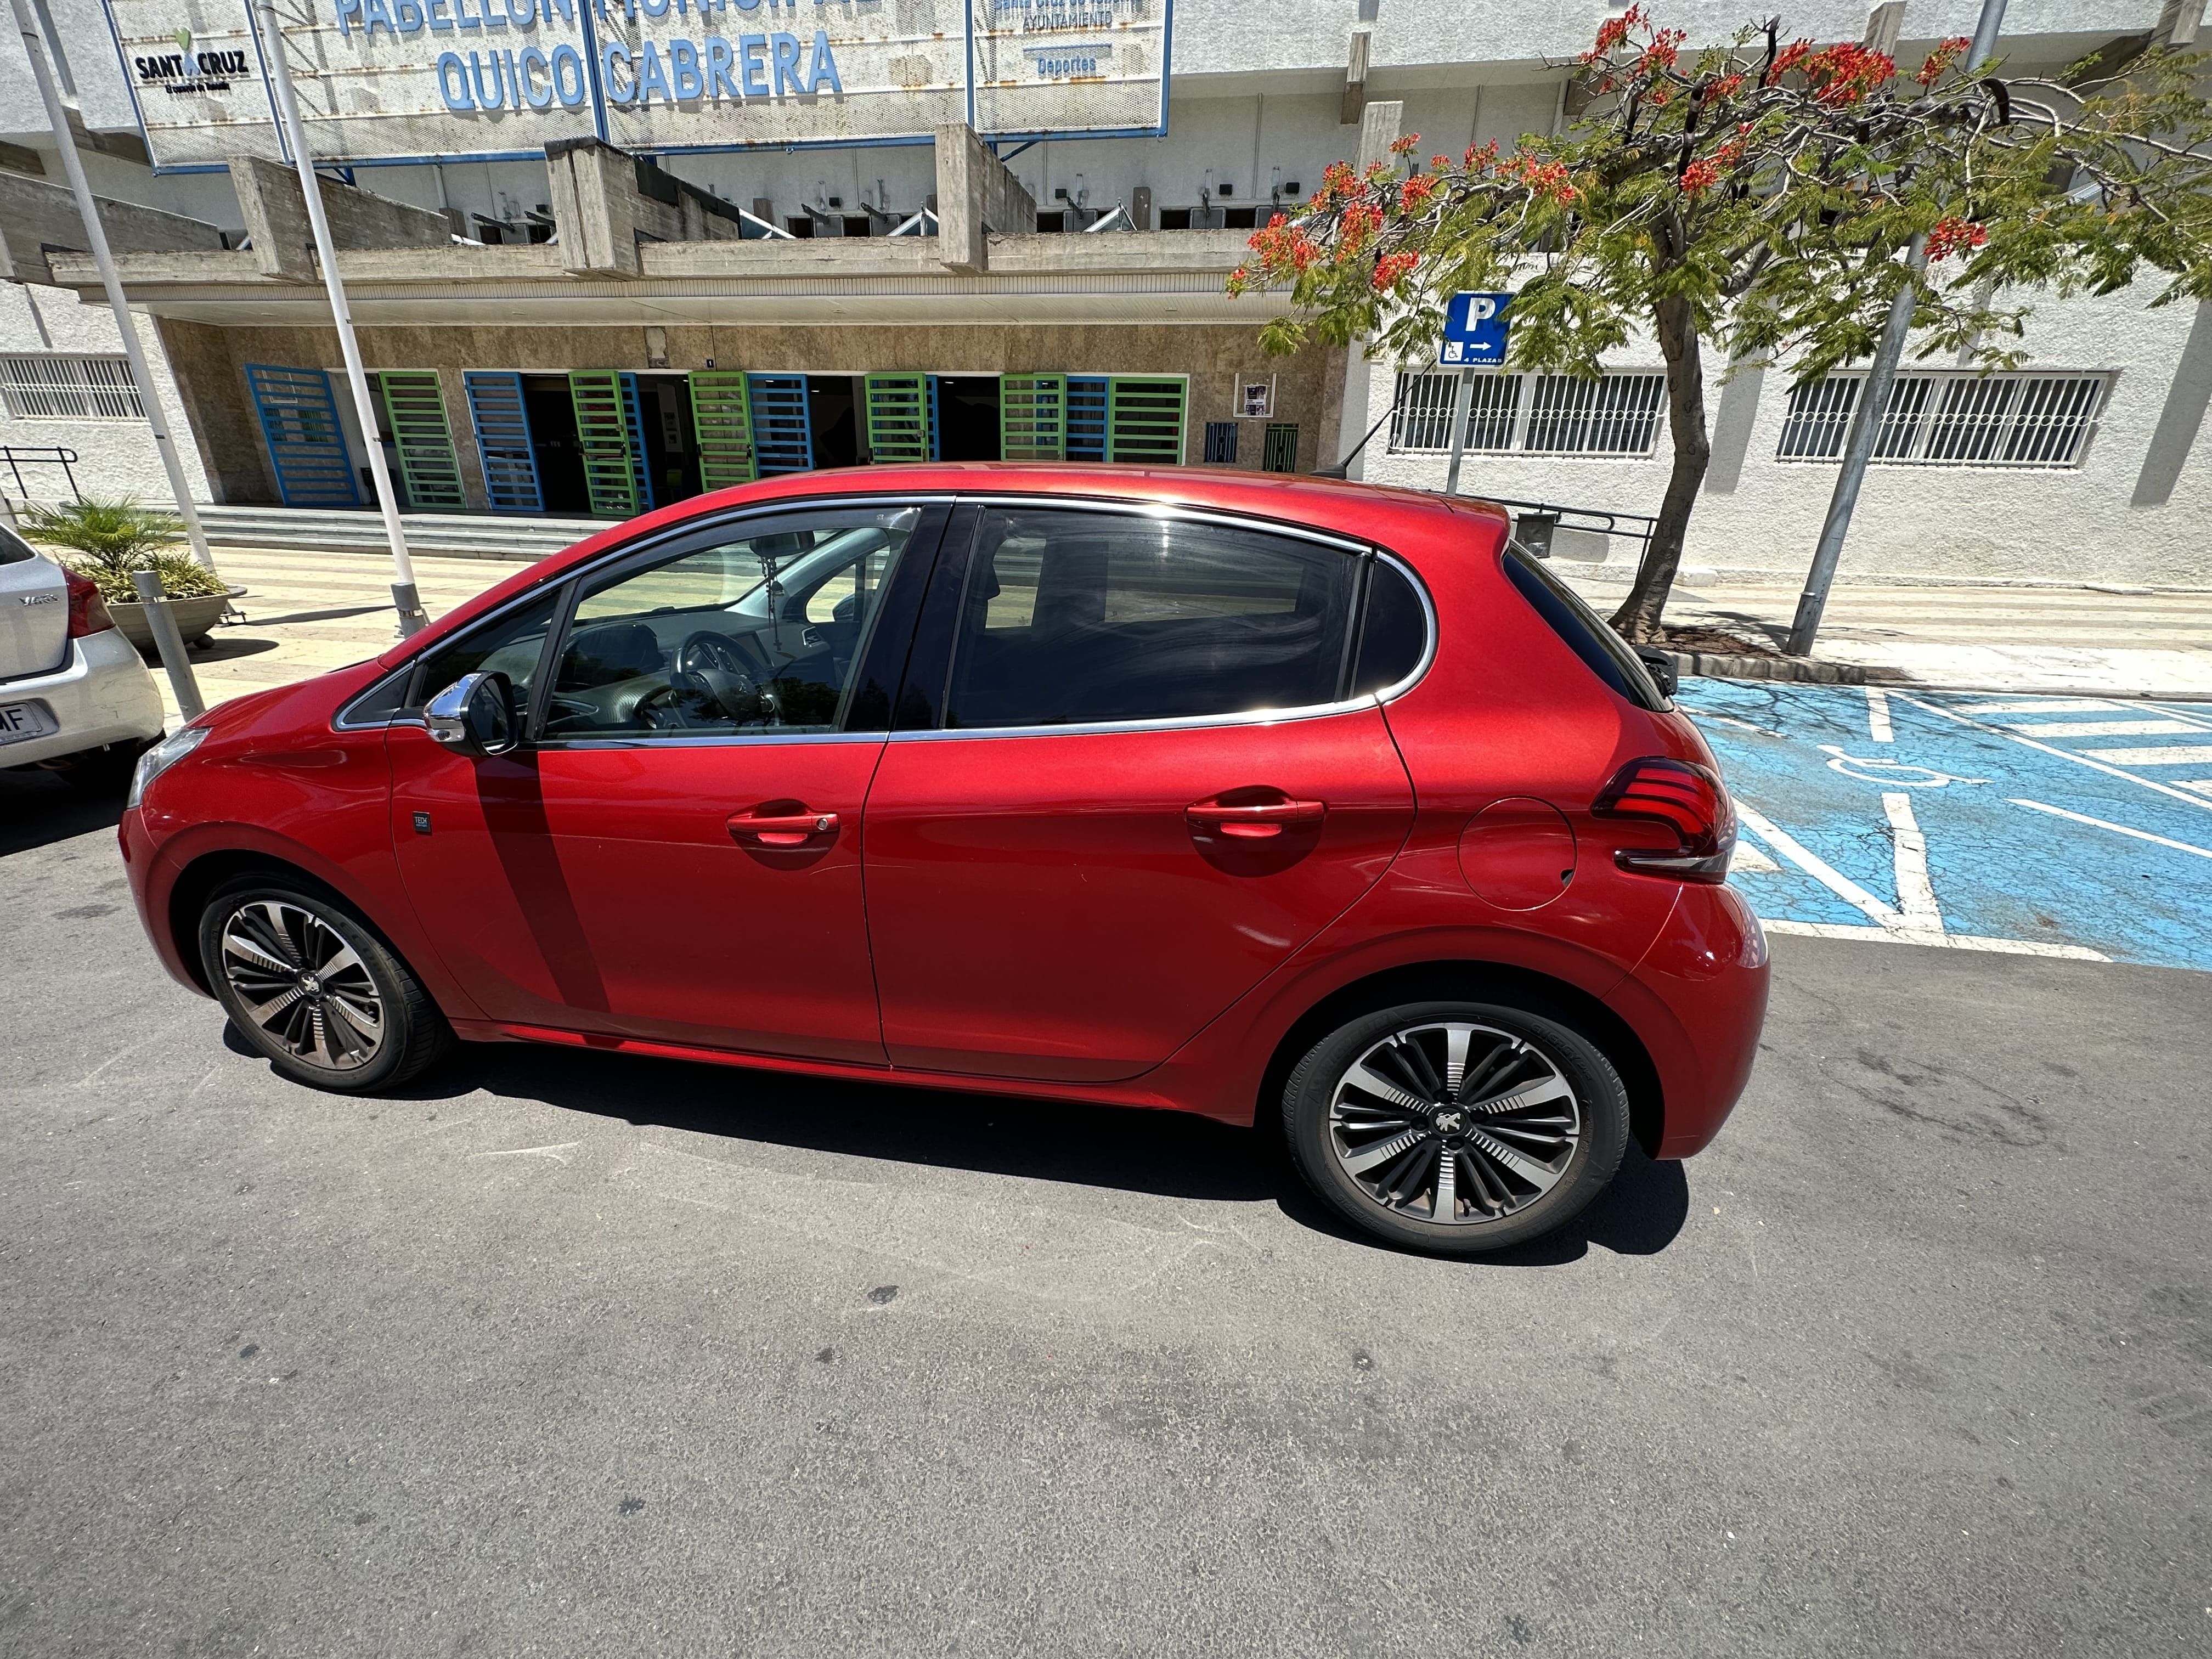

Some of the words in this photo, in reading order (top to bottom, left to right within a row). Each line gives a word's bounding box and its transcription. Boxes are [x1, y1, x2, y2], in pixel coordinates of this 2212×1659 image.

[1023, 11, 1112, 29] AYUNTAMIENTO
[198, 50, 249, 75] CRUZ
[437, 44, 584, 110] QUICO
[603, 31, 843, 103] CABRERA
[1036, 56, 1096, 76] Deportes
[1465, 297, 1496, 331] P
